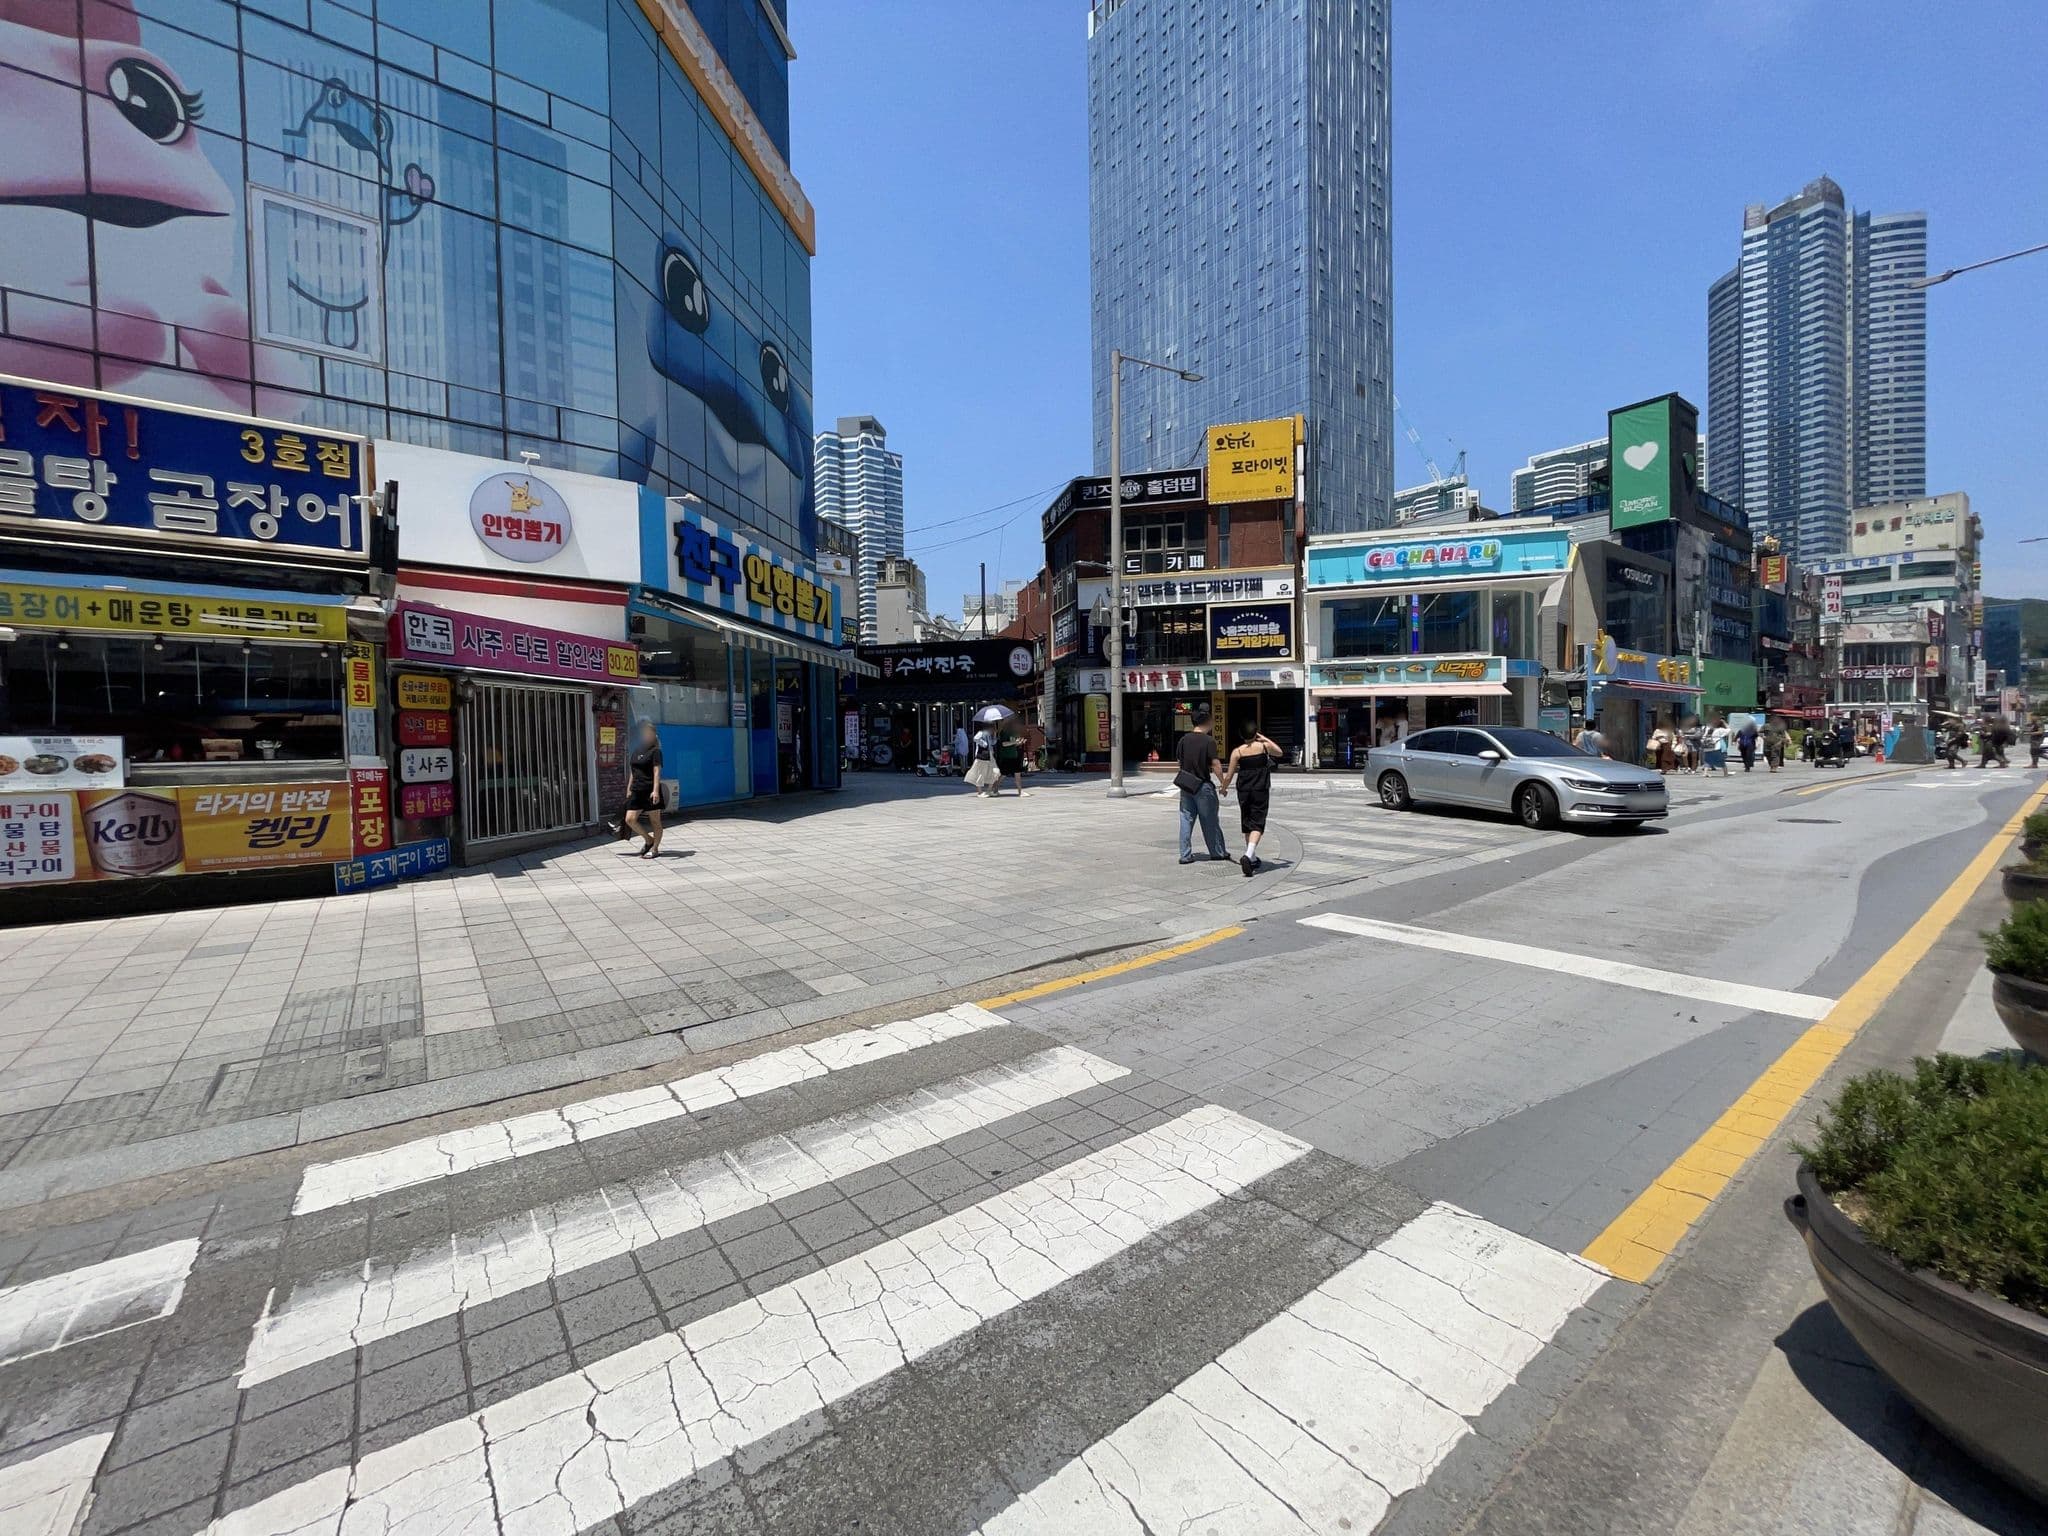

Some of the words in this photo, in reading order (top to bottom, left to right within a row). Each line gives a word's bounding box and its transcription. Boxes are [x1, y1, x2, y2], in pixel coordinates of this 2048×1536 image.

[240, 430, 350, 478] 3호점
[1231, 456, 1287, 474] 프라이빗
[1147, 476, 1197, 495] 홀덤펍
[149, 468, 351, 548] 곰장어
[482, 514, 562, 544] 인형뽑기
[1167, 555, 1204, 569] 카페
[1368, 548, 1436, 567] GACHA
[1440, 543, 1496, 561] HARU
[1768, 557, 1780, 583] BAR
[674, 521, 741, 595] 친구
[743, 554, 833, 629] 인형뽑기
[1180, 577, 1263, 595] 보드게임카페
[1825, 580, 1840, 613] 개미집
[555, 640, 605, 671] 할인샵
[1216, 635, 1286, 649] 보드게임카페
[353, 661, 371, 703] 물회
[425, 719, 448, 733] 타로
[419, 756, 448, 773] 사주
[195, 791, 275, 816] 라거의
[281, 789, 332, 812] 반전
[358, 787, 385, 848] 포장
[92, 814, 177, 846] Kelly
[244, 813, 332, 849] 켈리
[370, 849, 421, 880] 조개구이
[425, 842, 448, 866] 횟집
